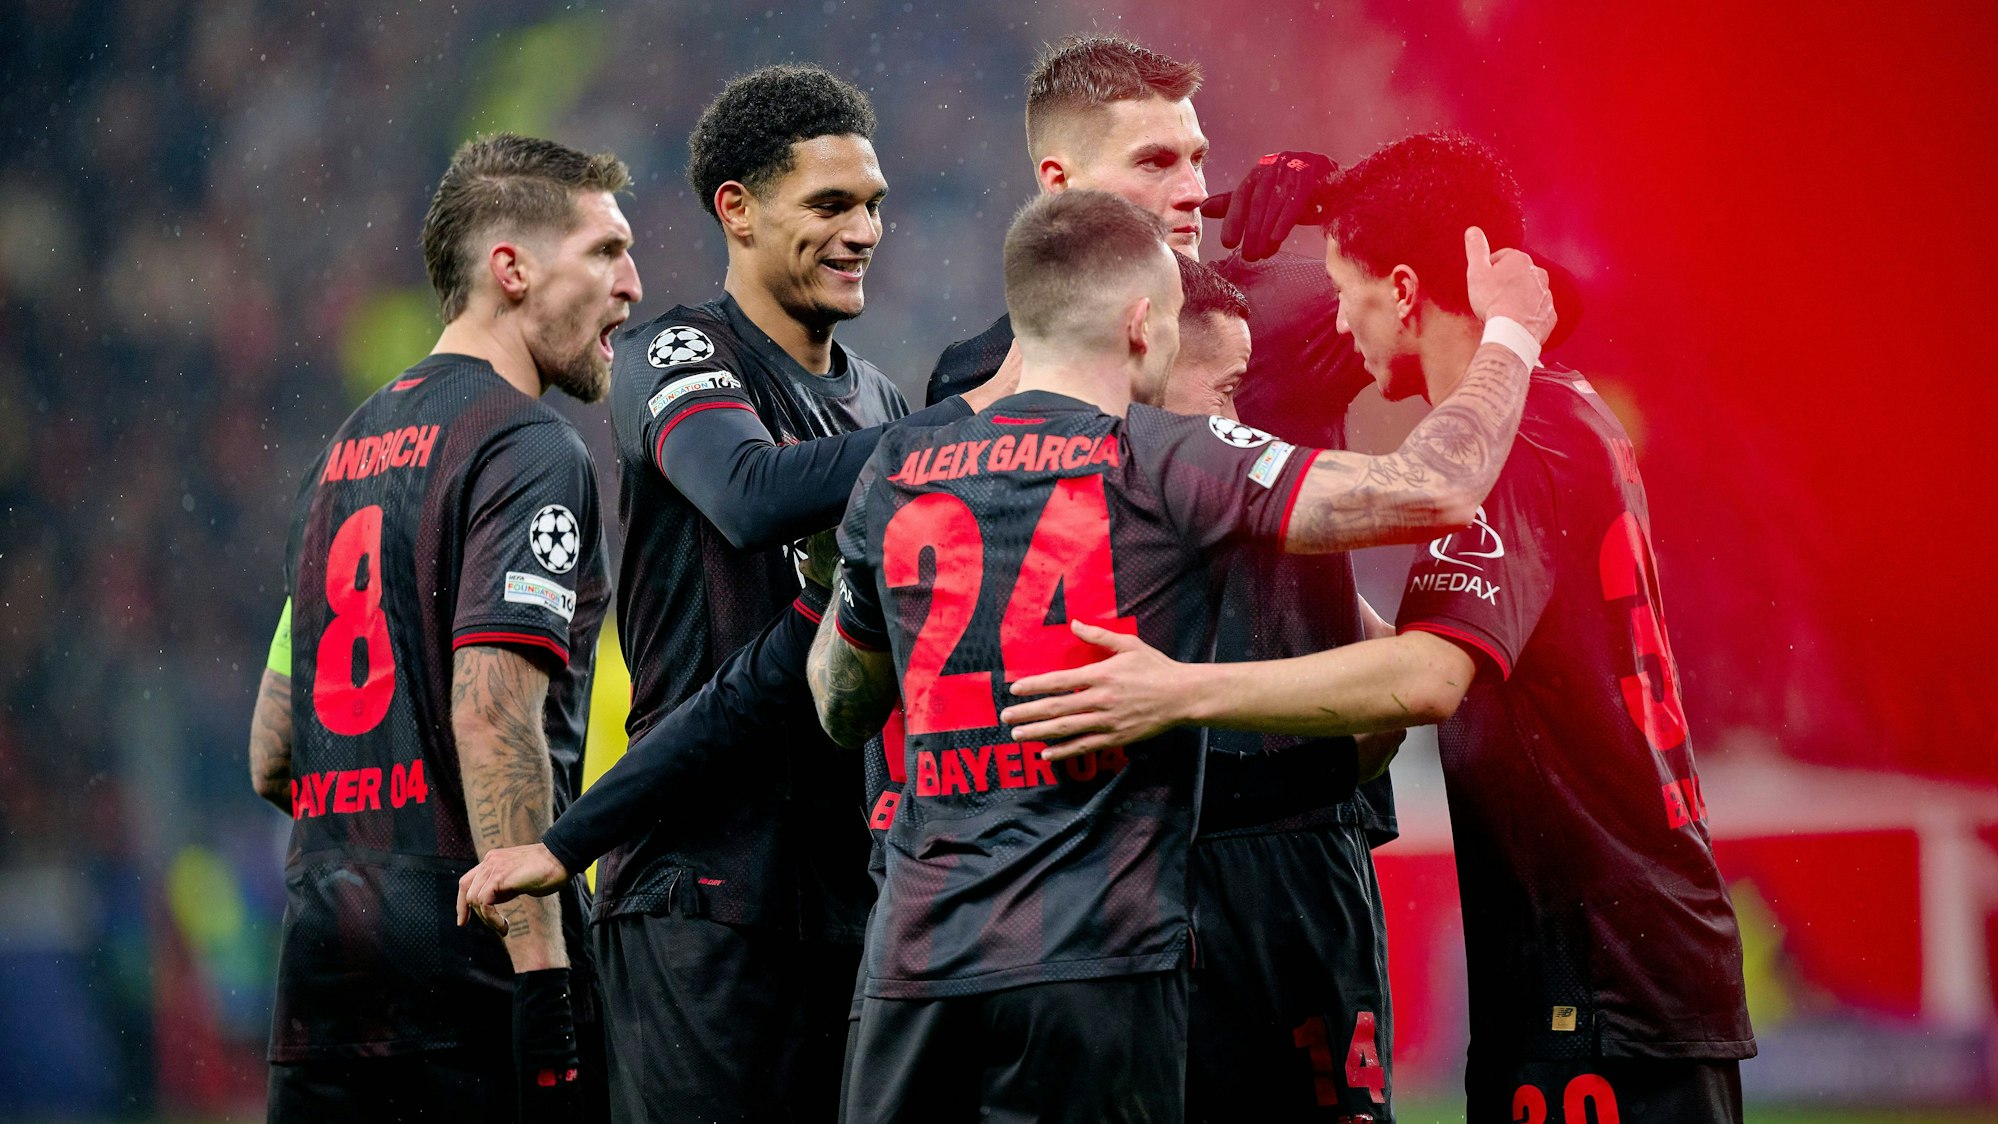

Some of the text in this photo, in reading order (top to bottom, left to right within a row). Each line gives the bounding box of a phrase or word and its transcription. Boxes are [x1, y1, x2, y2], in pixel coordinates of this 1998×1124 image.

[652, 382, 709, 414] FOUNDATION
[320, 424, 440, 486] ANDRICH
[886, 439, 991, 486] ALEIX
[883, 474, 1139, 735] 24
[1409, 573, 1501, 606] NIEDAX
[313, 504, 396, 737] 8
[390, 758, 429, 809] 04
[916, 741, 1058, 797] BAYER
